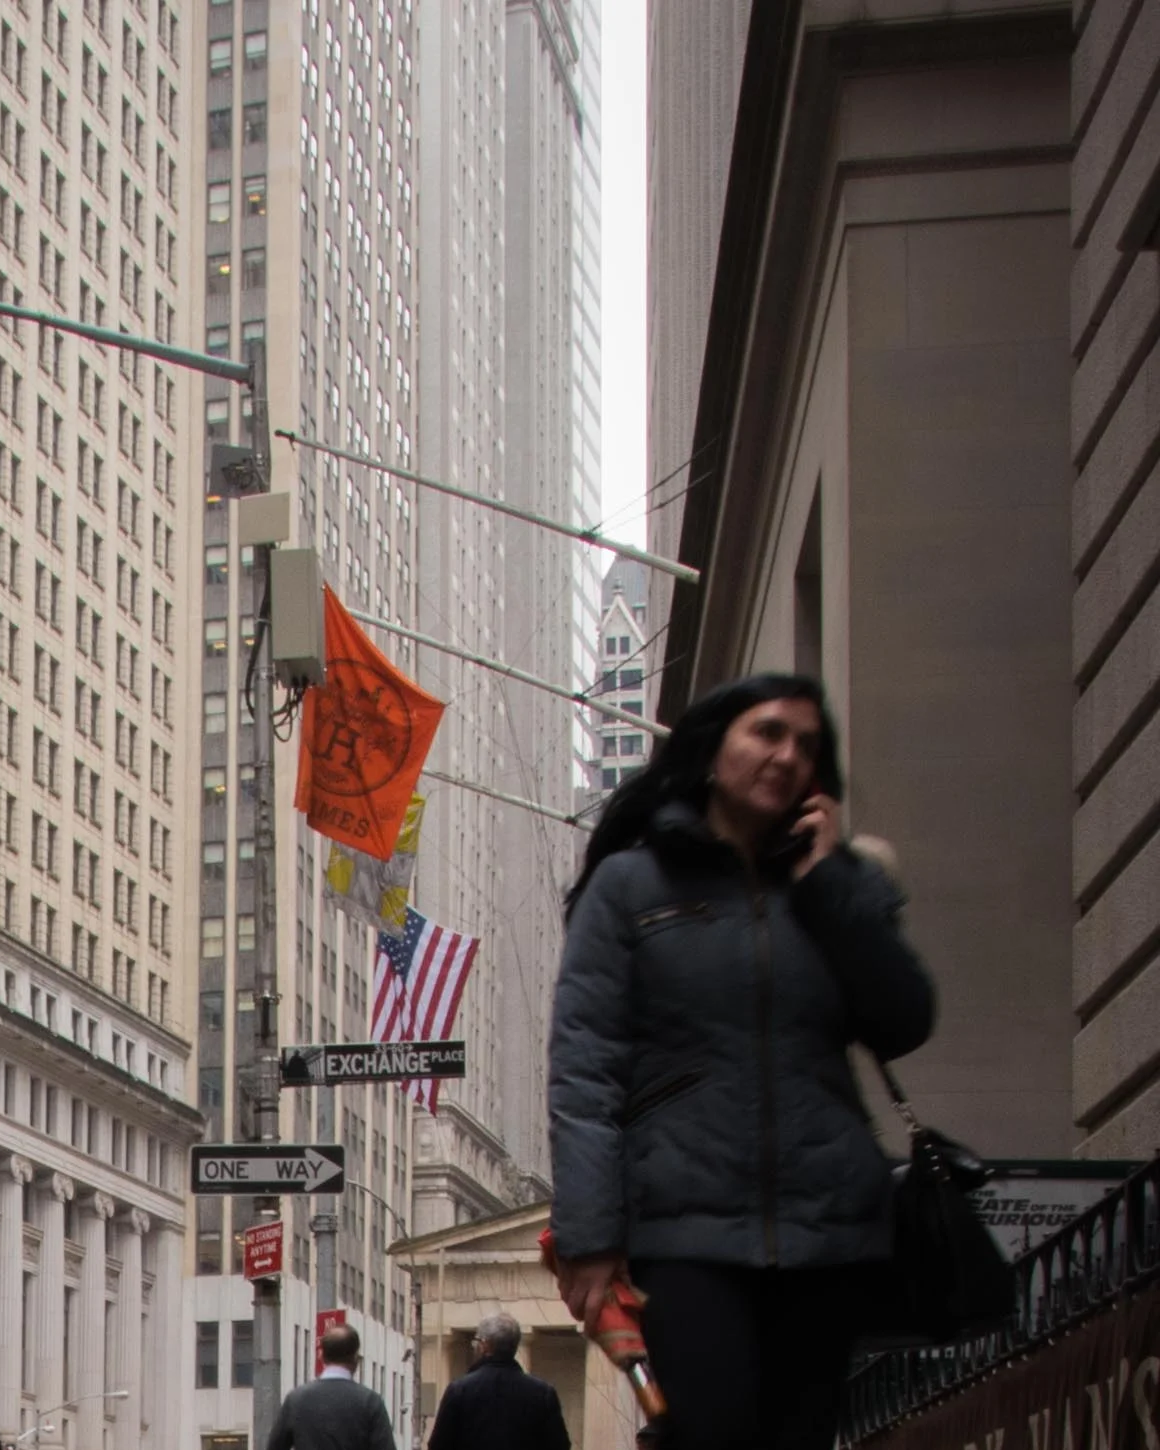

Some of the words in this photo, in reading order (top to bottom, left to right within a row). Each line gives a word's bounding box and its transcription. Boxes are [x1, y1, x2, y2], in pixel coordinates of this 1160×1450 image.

[326, 1052, 432, 1076] EXCHANGE
[431, 1049, 465, 1063] PLACE
[204, 1161, 249, 1180] ONE
[276, 1161, 324, 1180] WAY
